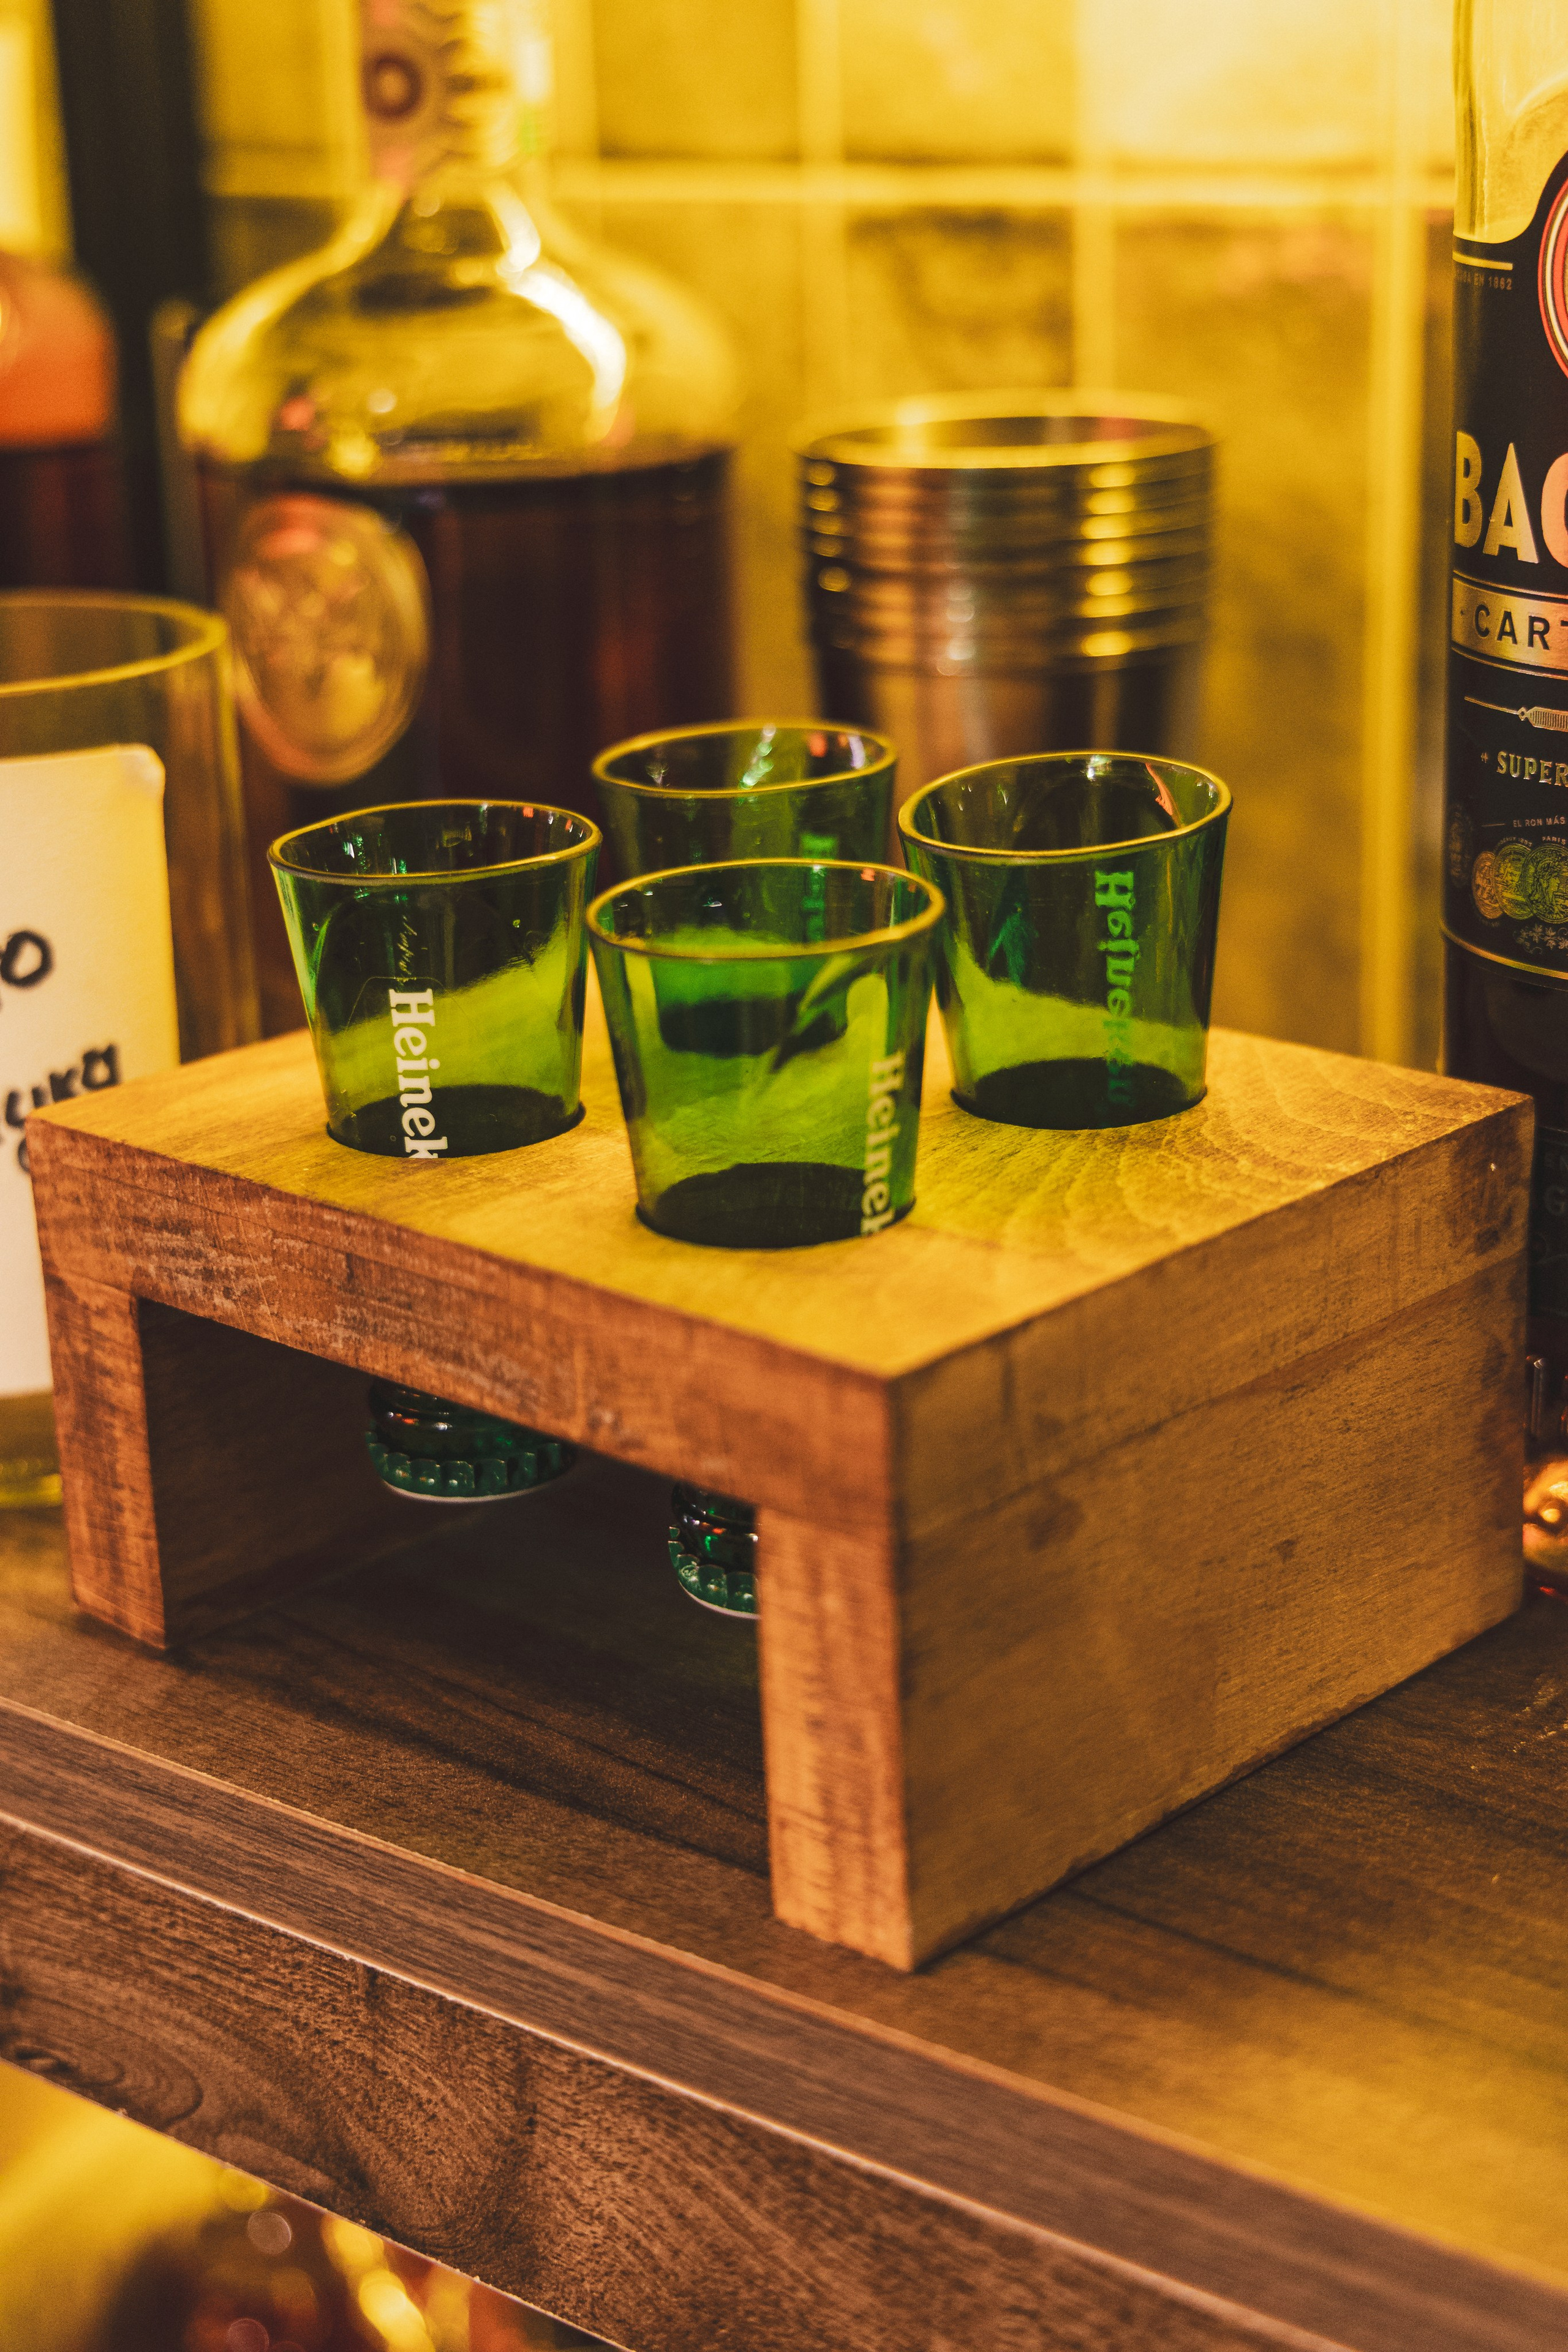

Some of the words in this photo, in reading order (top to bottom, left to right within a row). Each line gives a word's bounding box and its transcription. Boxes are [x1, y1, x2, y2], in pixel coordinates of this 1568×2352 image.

[1488, 276, 1512, 290] 1862
[1474, 604, 1568, 650] CAR
[1496, 750, 1568, 788] SUPER
[1525, 818, 1542, 827] RON
[1545, 815, 1566, 826] MÁS
[1542, 835, 1566, 845] PARIS
[389, 988, 448, 1159] Heinek
